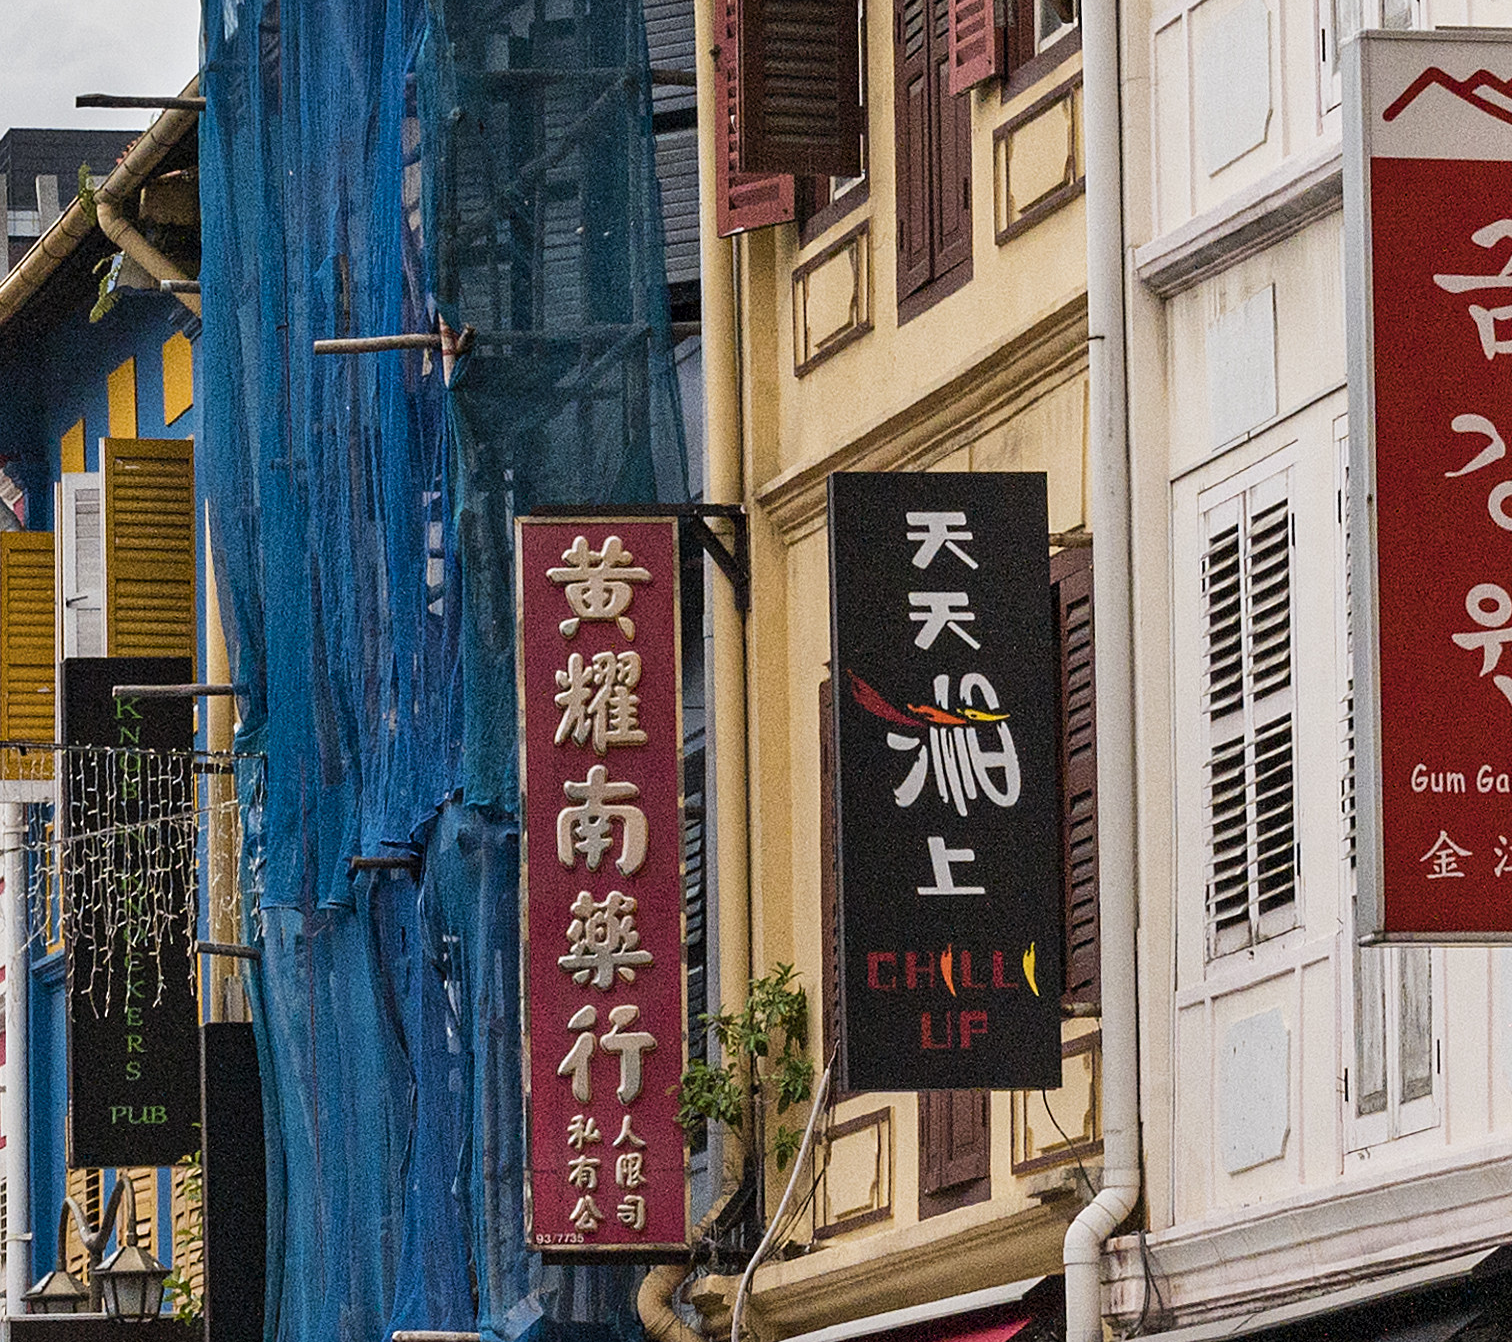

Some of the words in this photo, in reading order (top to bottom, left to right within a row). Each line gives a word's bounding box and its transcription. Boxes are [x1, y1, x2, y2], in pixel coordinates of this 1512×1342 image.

[1411, 764, 1466, 796] Gum
[866, 942, 1041, 998] CHILLI
[921, 1010, 989, 1049] UP
[110, 1105, 168, 1126] PUB
